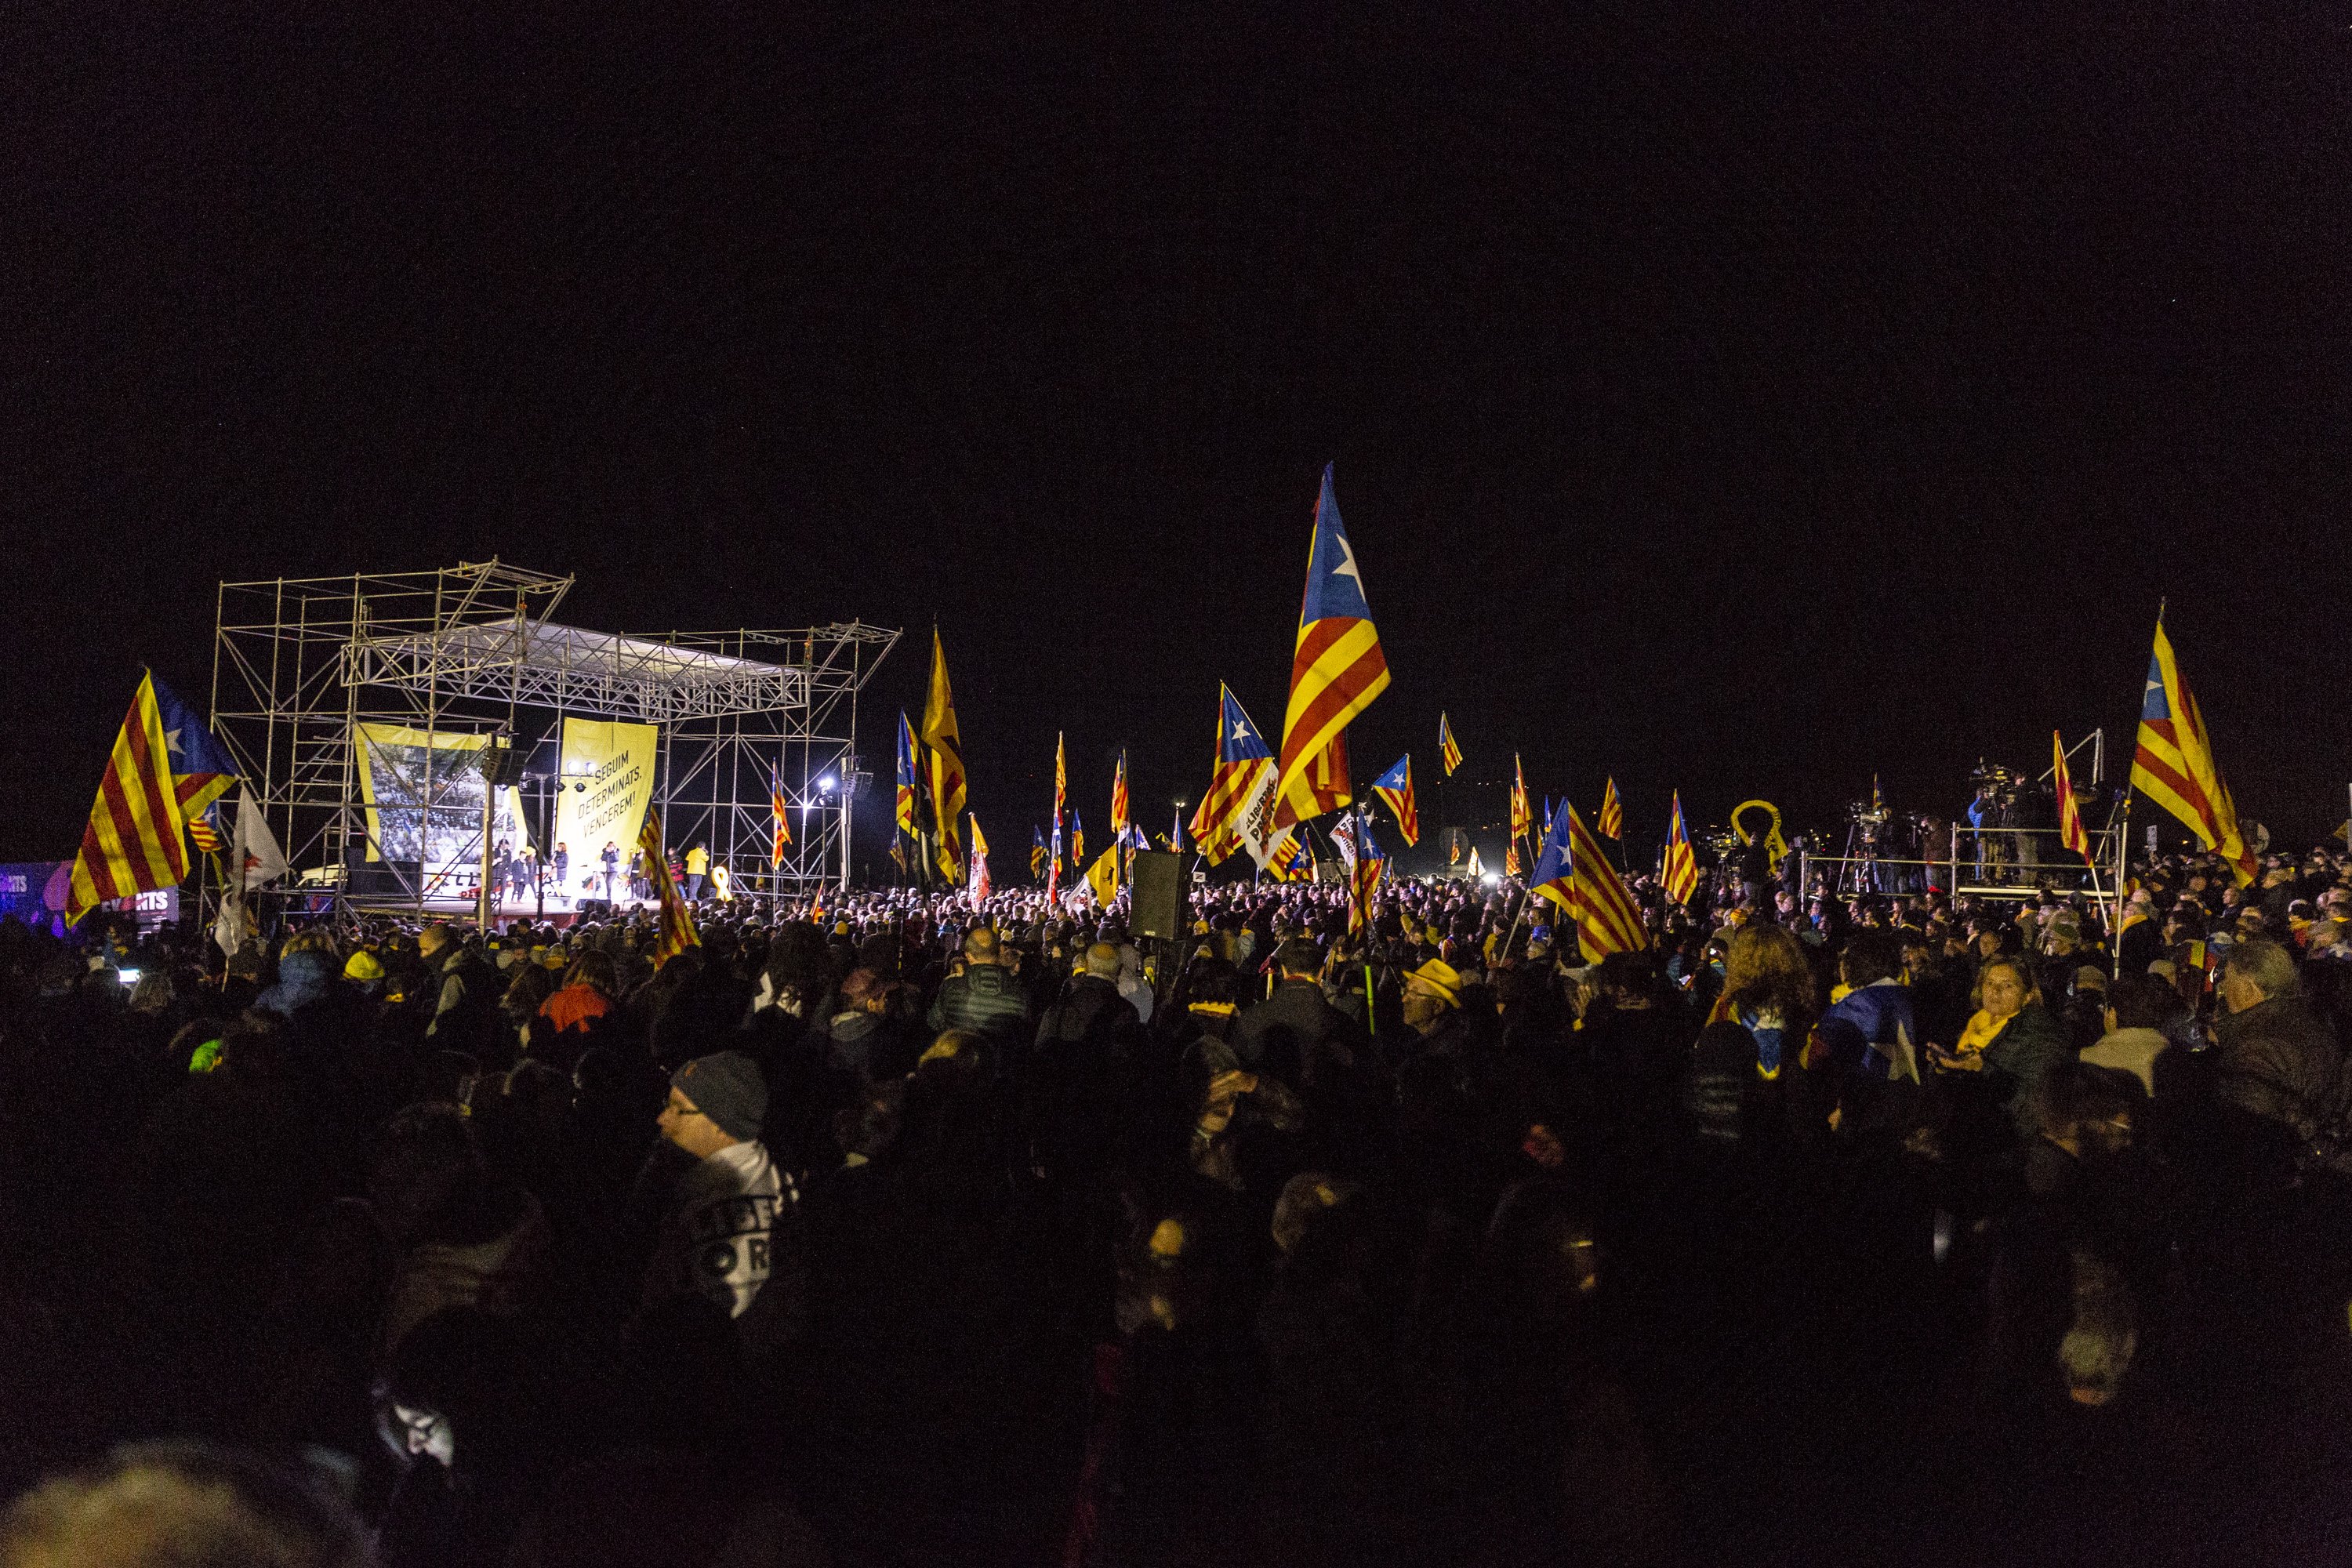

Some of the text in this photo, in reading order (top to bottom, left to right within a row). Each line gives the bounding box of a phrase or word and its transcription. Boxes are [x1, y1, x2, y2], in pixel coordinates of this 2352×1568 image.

[594, 750, 629, 786] SEGUIM
[578, 765, 642, 820] DETERMINATS.
[583, 790, 636, 838] VENCEREM!
